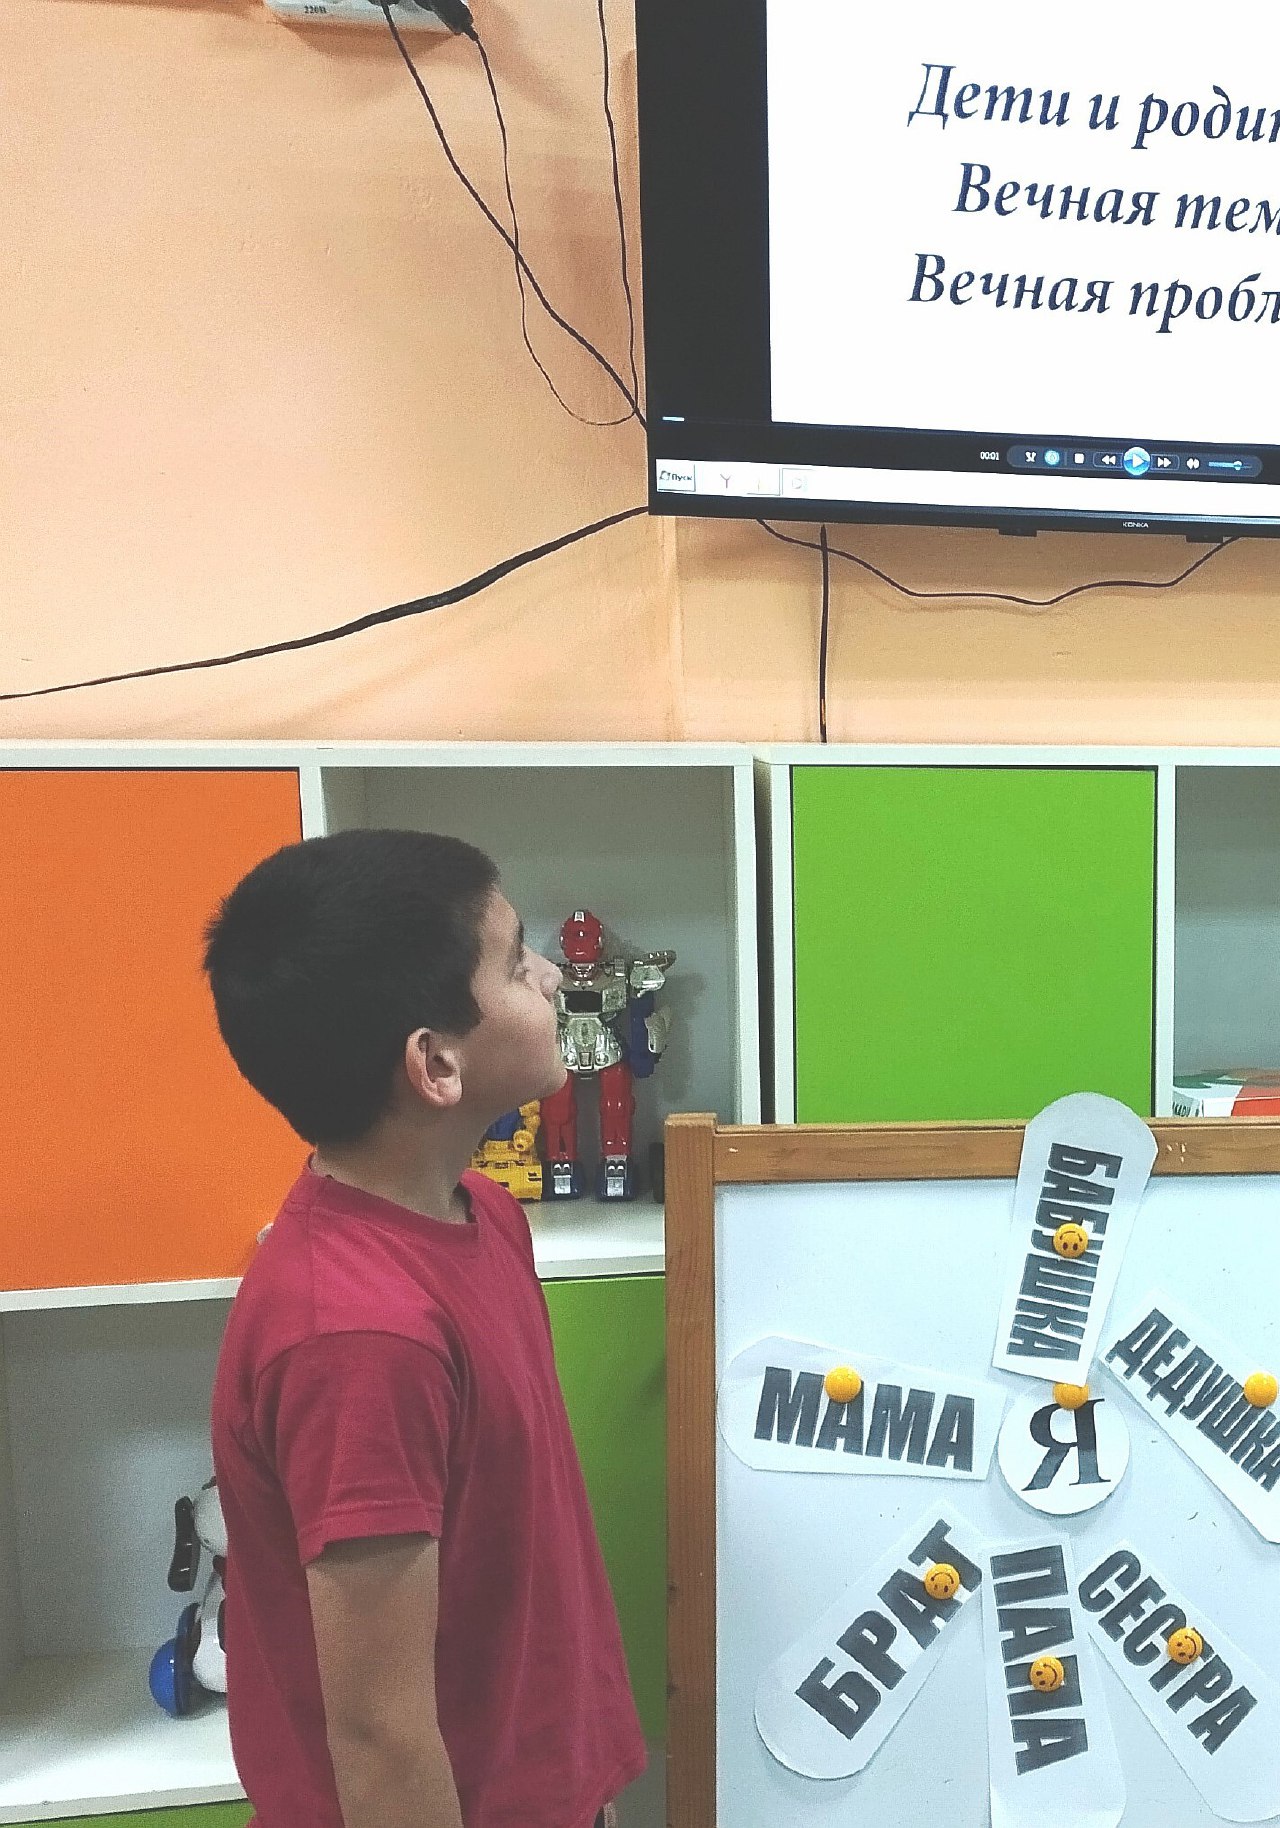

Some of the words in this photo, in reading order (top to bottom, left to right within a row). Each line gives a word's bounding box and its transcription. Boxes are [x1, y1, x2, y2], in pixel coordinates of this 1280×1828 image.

[907, 63, 1070, 130] Дети
[1089, 94, 1120, 131] и
[951, 162, 1160, 226] Вечная
[907, 253, 1115, 313] Вечная
[671, 473, 692, 483] Пуск
[980, 451, 1000, 461] 00:01
[1006, 1143, 1123, 1361] БАБУШКА
[754, 1366, 975, 1472] МАМА
[1021, 1398, 1111, 1491] Я
[795, 1518, 982, 1740] БРАТ
[990, 1545, 1088, 1775] ПАПА
